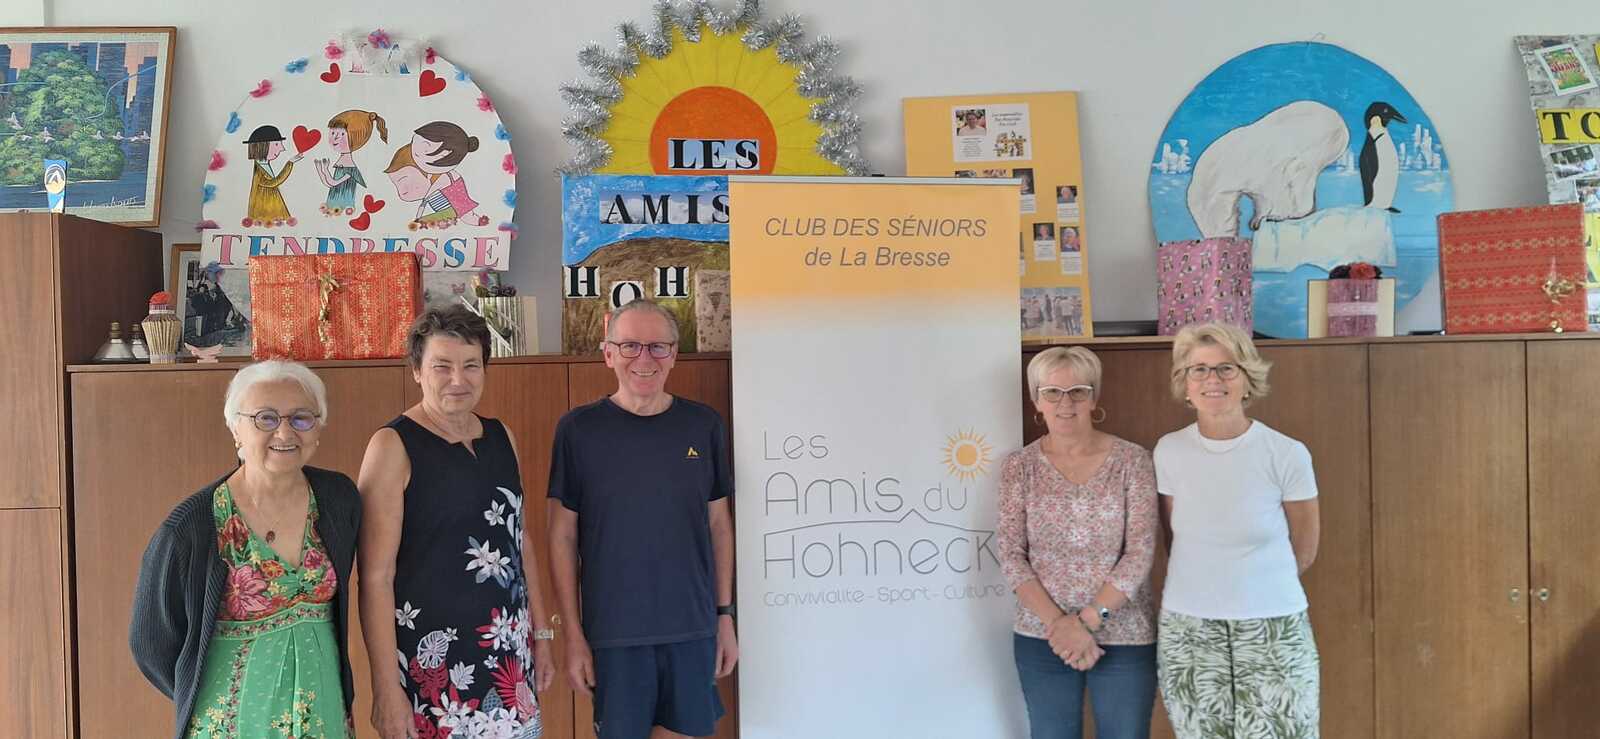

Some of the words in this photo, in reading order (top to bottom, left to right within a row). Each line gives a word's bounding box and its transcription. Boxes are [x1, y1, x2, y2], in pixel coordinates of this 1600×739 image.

[671, 139, 758, 169] LES
[765, 217, 826, 236] CLUB
[833, 218, 880, 236] DES
[887, 215, 987, 237] SÉNIORS
[804, 247, 832, 266] de
[840, 248, 867, 266] La
[875, 247, 951, 266] Bresse
[764, 431, 830, 460] Les
[765, 471, 904, 516] Amis
[923, 482, 968, 512] du
[877, 586, 931, 604] Sport
[943, 582, 1006, 601] Culture
